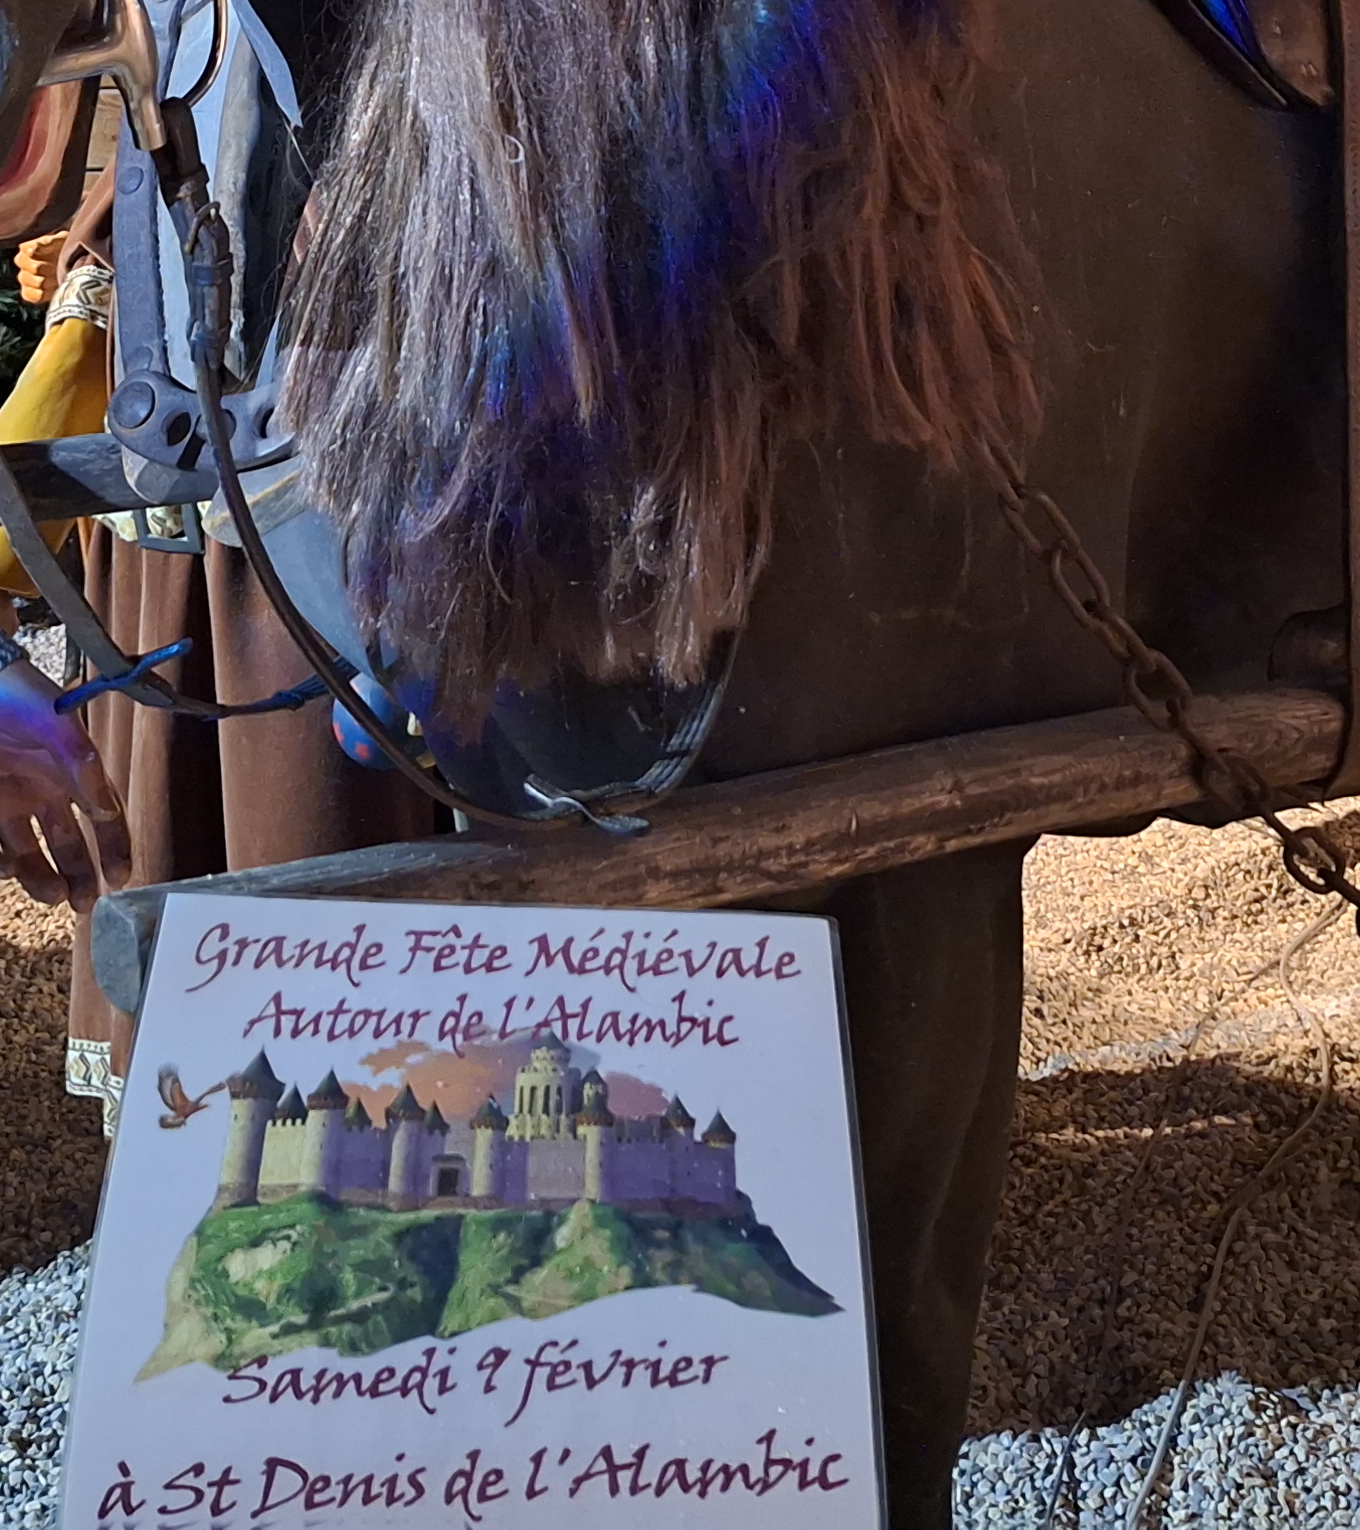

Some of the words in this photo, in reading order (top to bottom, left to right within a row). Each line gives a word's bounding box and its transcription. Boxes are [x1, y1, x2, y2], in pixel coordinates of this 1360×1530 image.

[186, 922, 387, 992] Grande
[398, 926, 510, 976] Fête
[525, 925, 803, 992] Médiévale
[243, 992, 431, 1039] Autour
[437, 991, 489, 1054] de
[498, 991, 740, 1047] l'Alambic
[222, 1344, 458, 1414] Samedi
[475, 1346, 506, 1396] 9
[504, 1340, 730, 1426] février
[97, 1460, 147, 1520] à
[157, 1462, 241, 1519] St
[250, 1452, 427, 1519] Denis
[443, 1449, 508, 1522] de
[524, 1427, 850, 1501] l'Alambic
